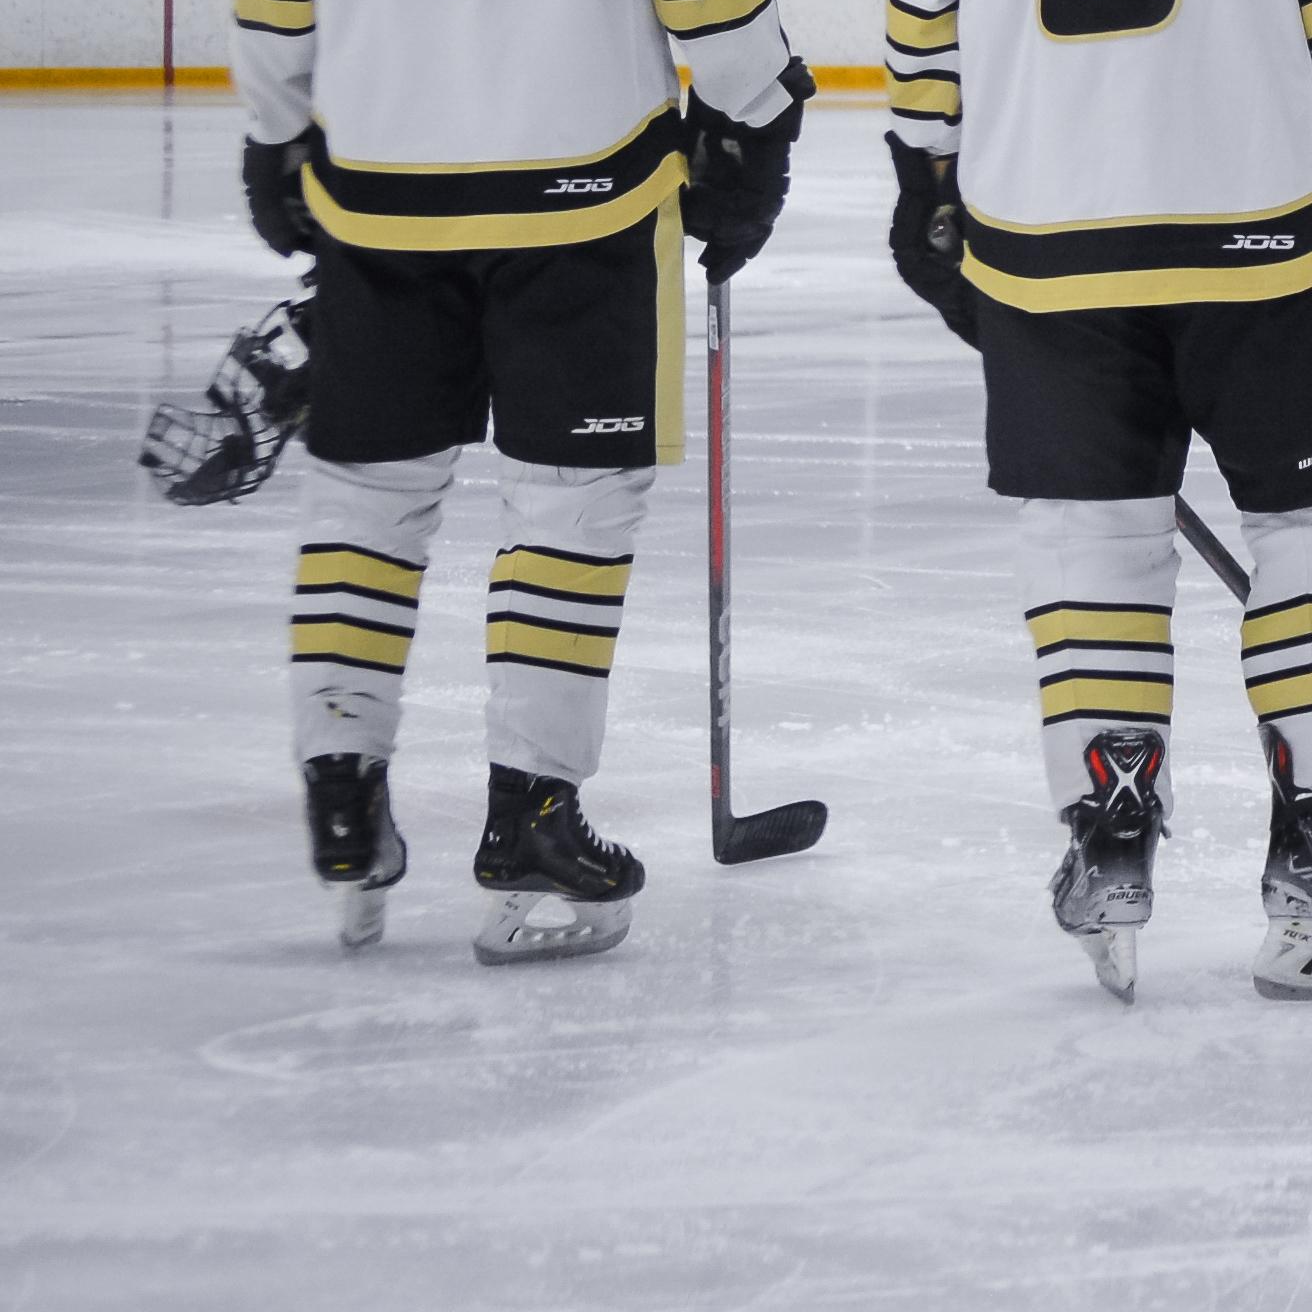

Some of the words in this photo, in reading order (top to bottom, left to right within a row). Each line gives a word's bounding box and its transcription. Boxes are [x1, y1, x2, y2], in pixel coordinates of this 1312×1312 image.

[544, 178, 613, 194] JOG
[1222, 234, 1295, 250] JOG
[572, 417, 644, 433] JOG
